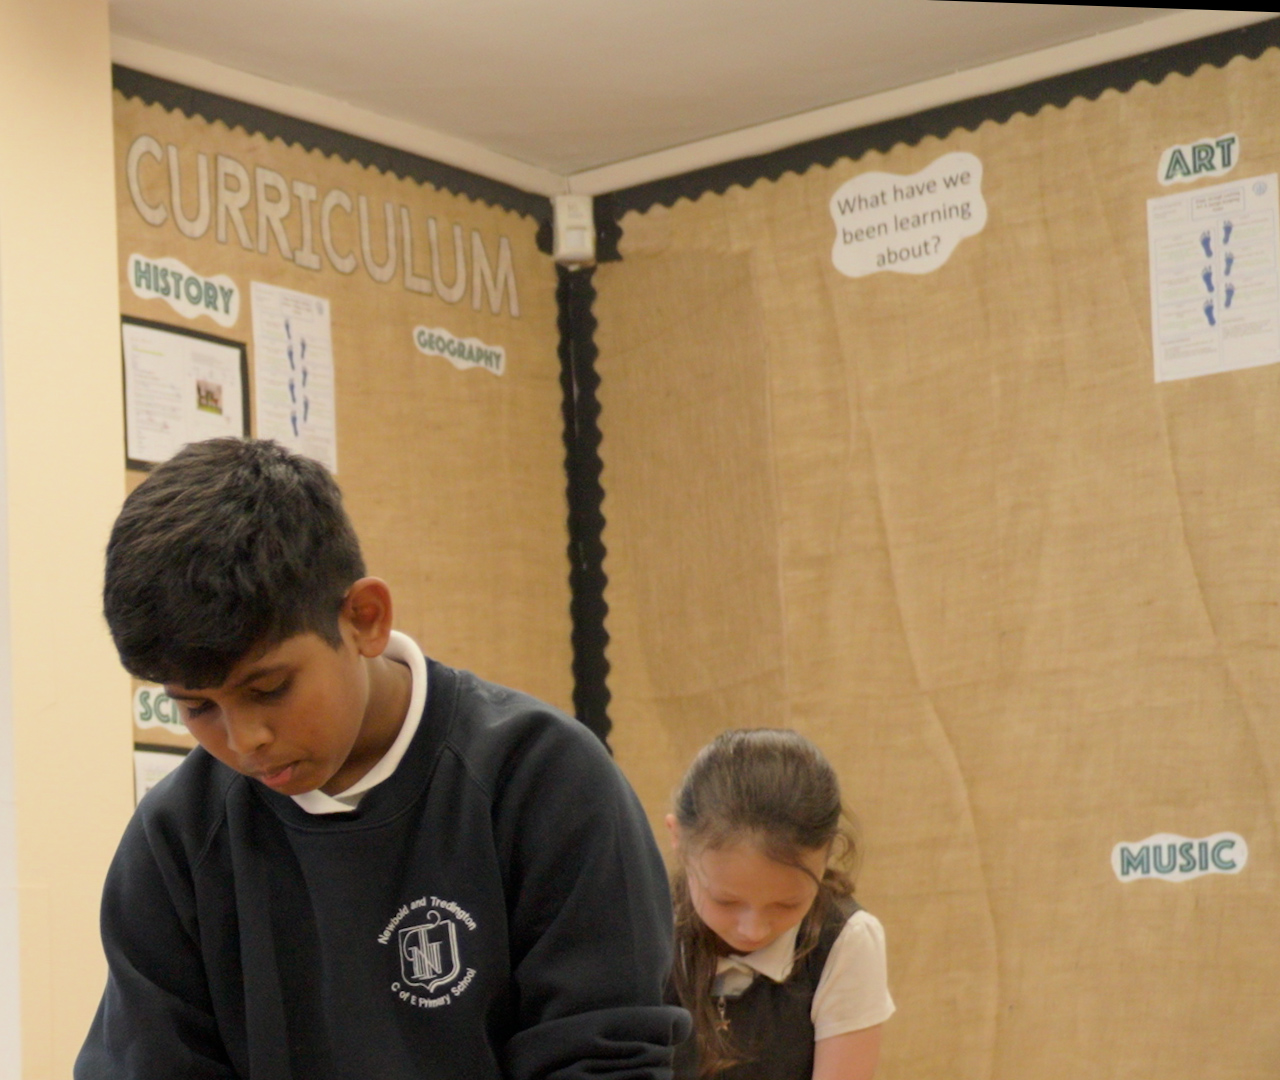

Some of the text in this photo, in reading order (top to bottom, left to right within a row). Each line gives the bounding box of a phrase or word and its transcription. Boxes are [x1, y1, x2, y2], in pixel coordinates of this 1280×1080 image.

[1163, 136, 1236, 181] ART
[837, 169, 972, 217] What have we
[126, 134, 521, 319] CURRICULUM
[842, 198, 972, 246] been learning
[875, 235, 941, 268] about?
[134, 258, 235, 316] HISTORY
[416, 330, 502, 370] GEOGRAPHY
[138, 690, 185, 726] SCI
[1119, 838, 1237, 876] MUSIC
[377, 896, 477, 945] Newbold and Tredington
[391, 967, 477, 1008] C of E Primary School
